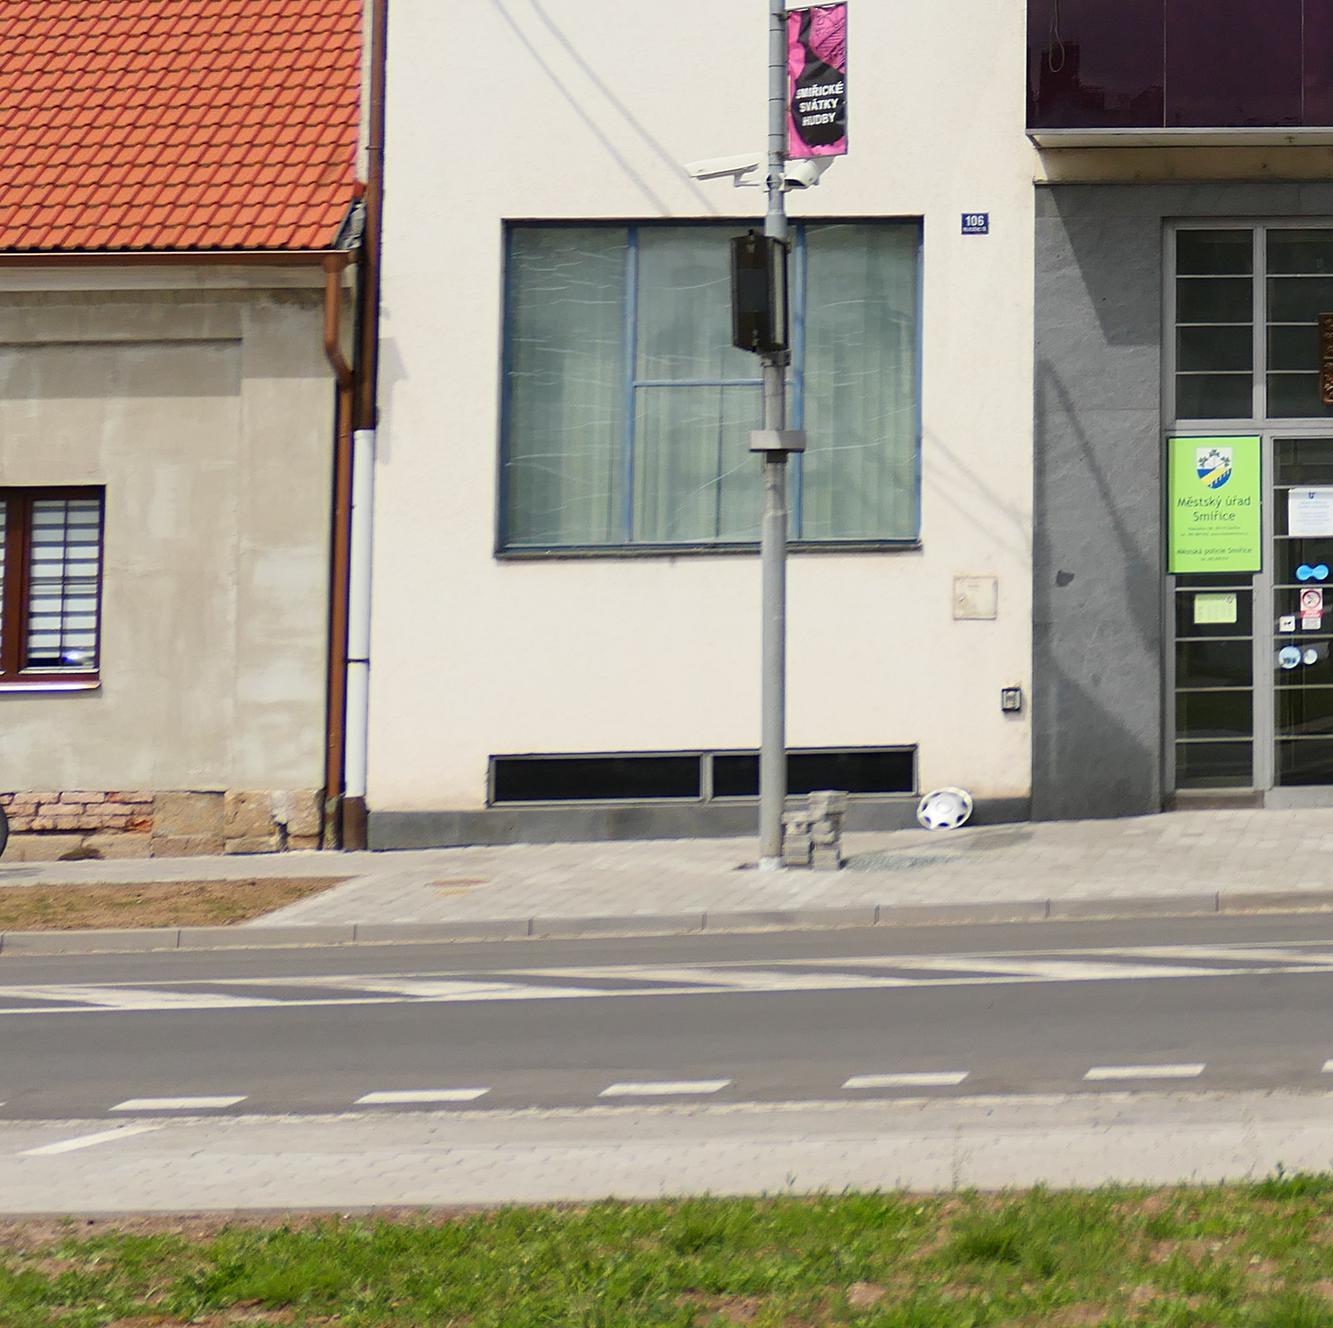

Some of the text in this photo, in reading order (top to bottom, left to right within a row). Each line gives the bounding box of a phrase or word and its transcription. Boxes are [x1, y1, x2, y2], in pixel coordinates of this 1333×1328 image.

[796, 81, 844, 99] SMIŘICKÉ
[799, 98, 839, 113] SVÁTKY
[802, 112, 836, 127] HUDBY
[965, 215, 985, 227] 106
[1177, 494, 1251, 509] Městský úřad
[1192, 510, 1237, 522] Smiřice
